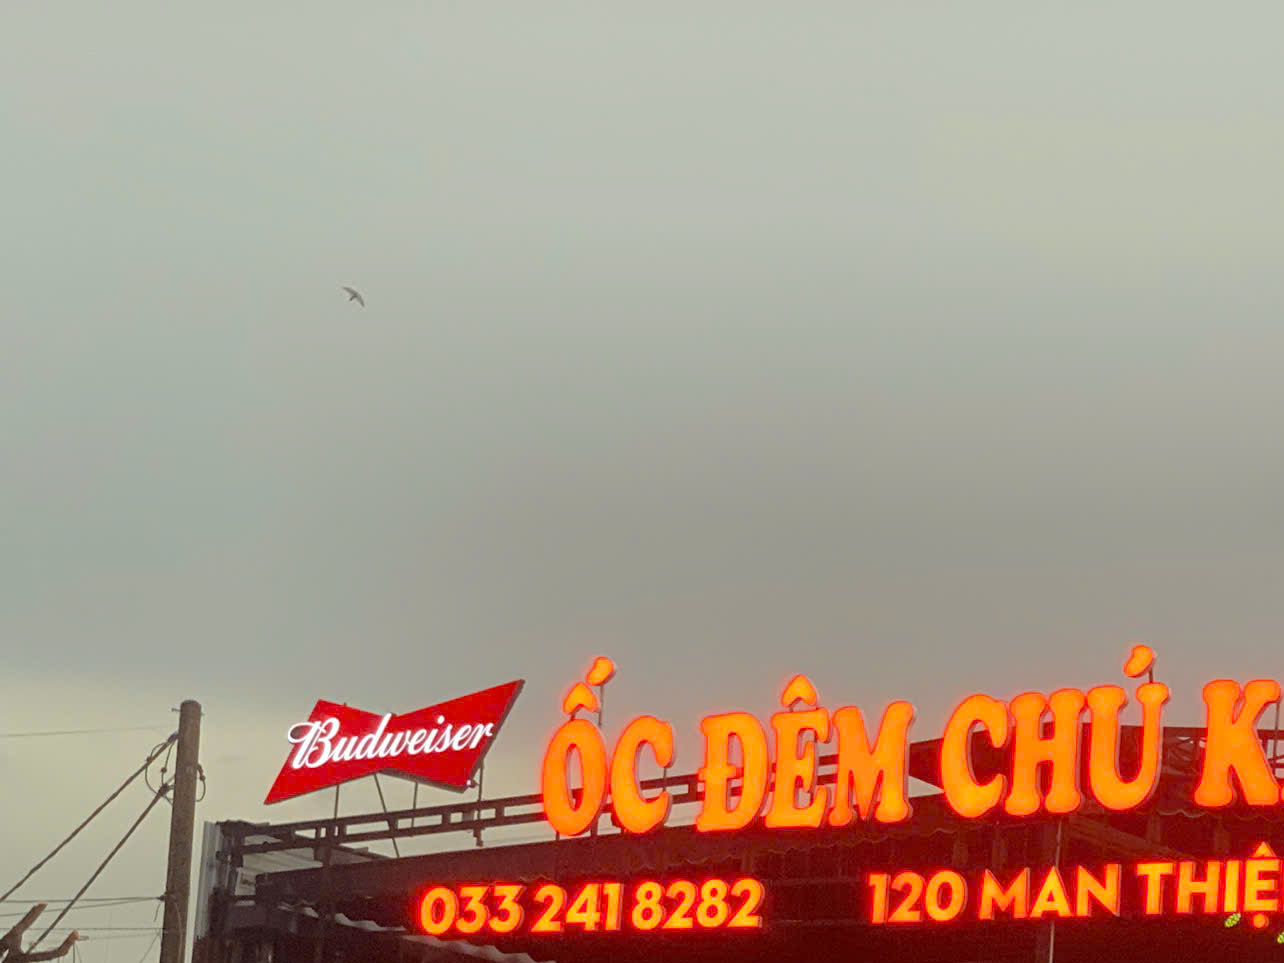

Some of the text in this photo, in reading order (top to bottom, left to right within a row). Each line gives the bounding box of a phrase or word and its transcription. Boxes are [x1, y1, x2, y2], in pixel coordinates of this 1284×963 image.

[287, 713, 493, 768] Budweiser
[541, 656, 676, 836] ỐC
[696, 675, 914, 832] ĐÊM
[939, 645, 1171, 819] CHÚ
[419, 878, 764, 936] 033 241 8282
[868, 869, 967, 924] 120
[977, 862, 1121, 921] MAN
